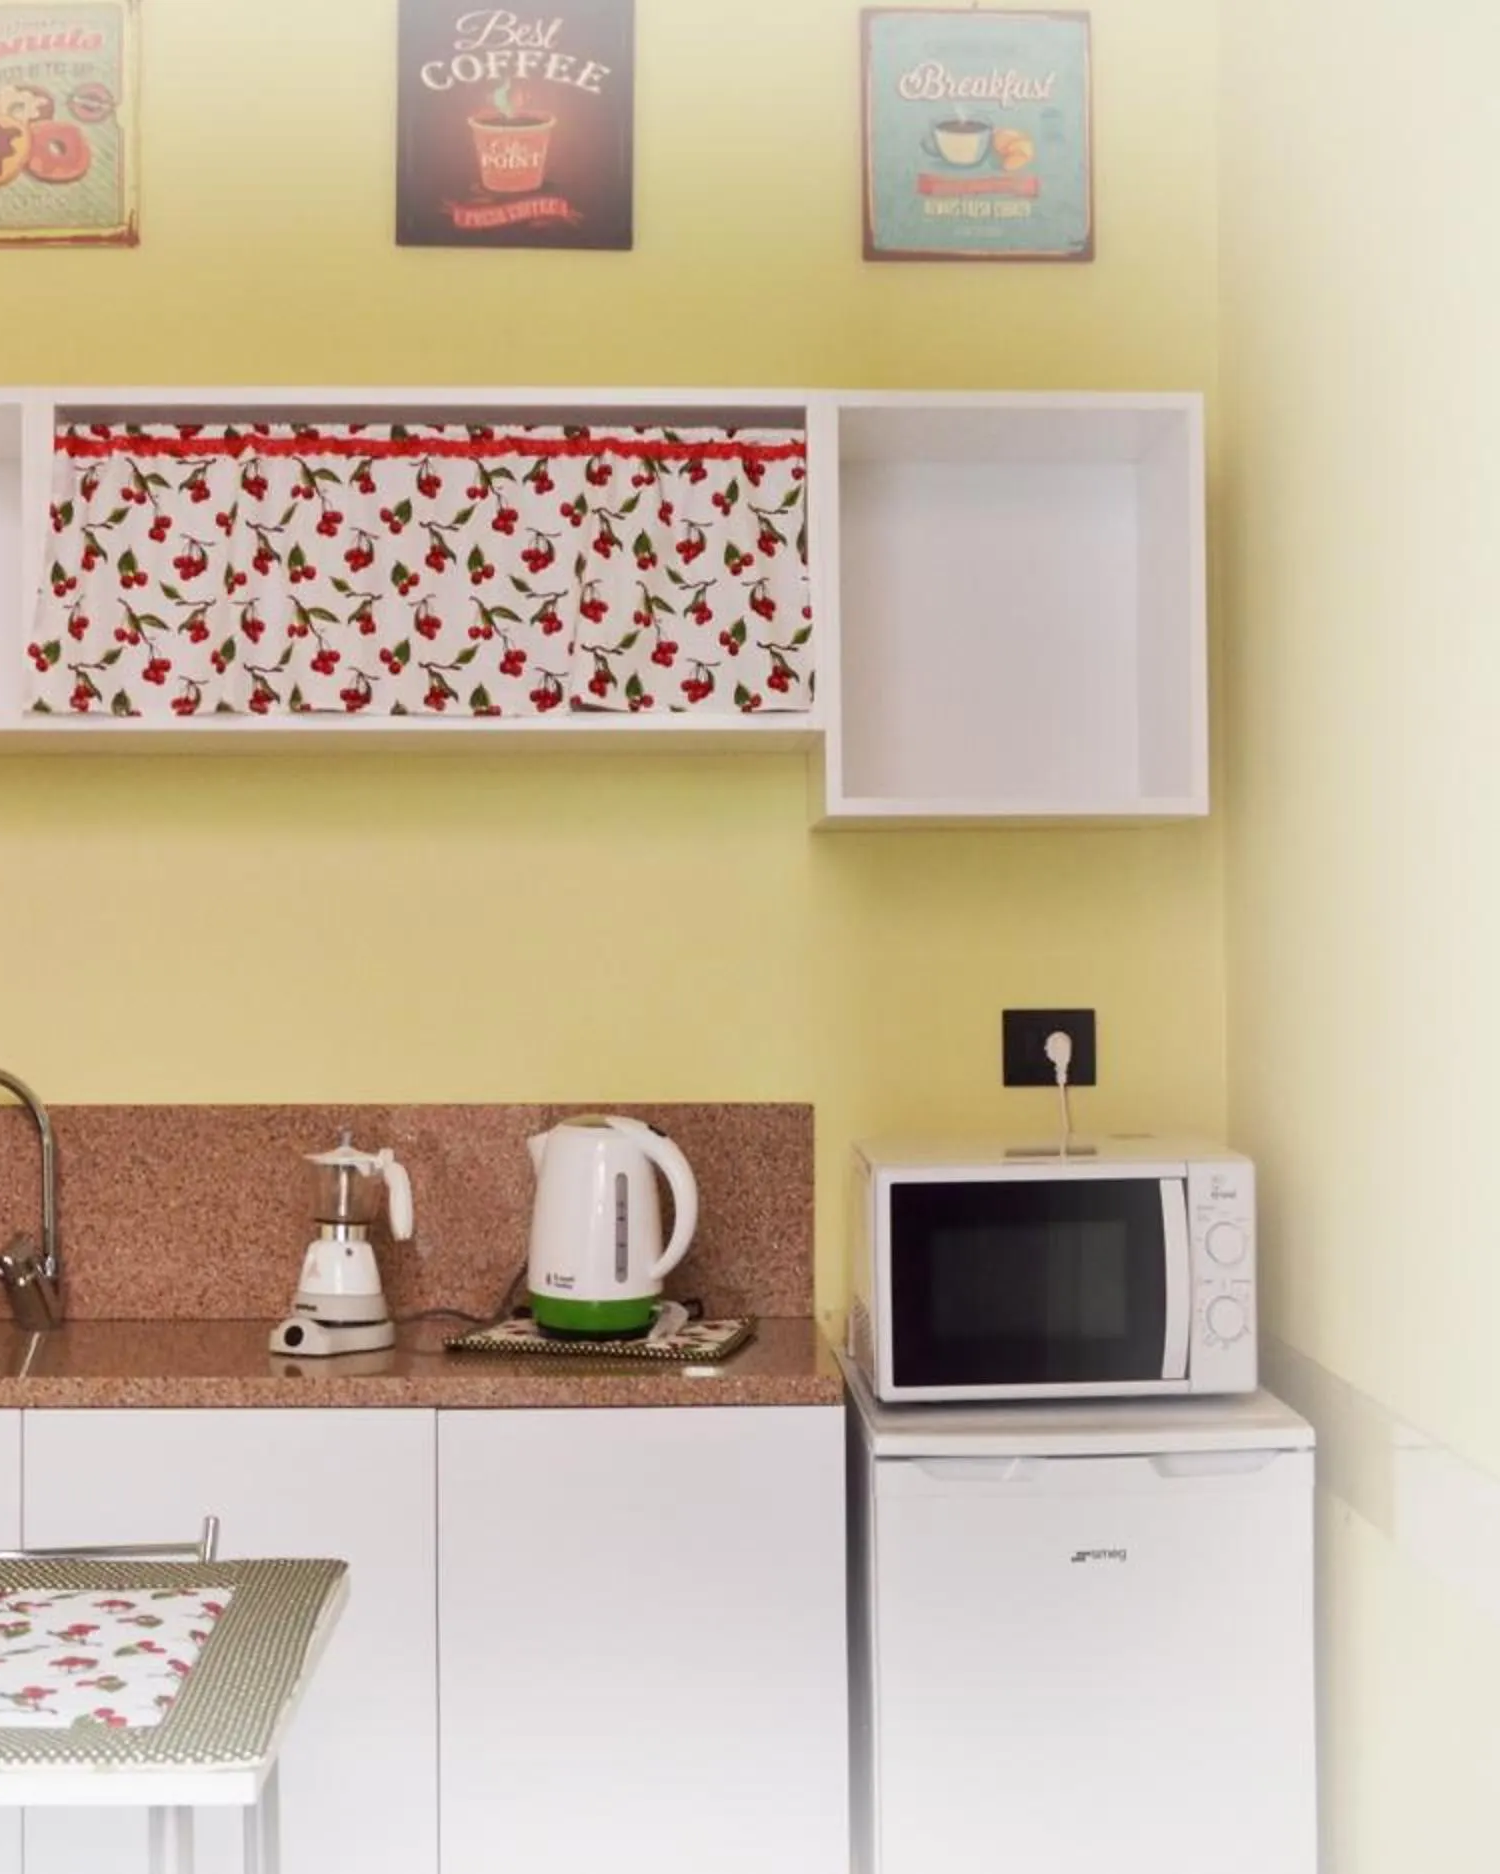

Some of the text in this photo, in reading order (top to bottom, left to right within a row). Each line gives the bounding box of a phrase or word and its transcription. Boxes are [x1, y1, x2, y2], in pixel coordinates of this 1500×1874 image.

[453, 9, 564, 51] Best
[420, 50, 612, 94] COFFEE
[898, 60, 1057, 110] Breakfast
